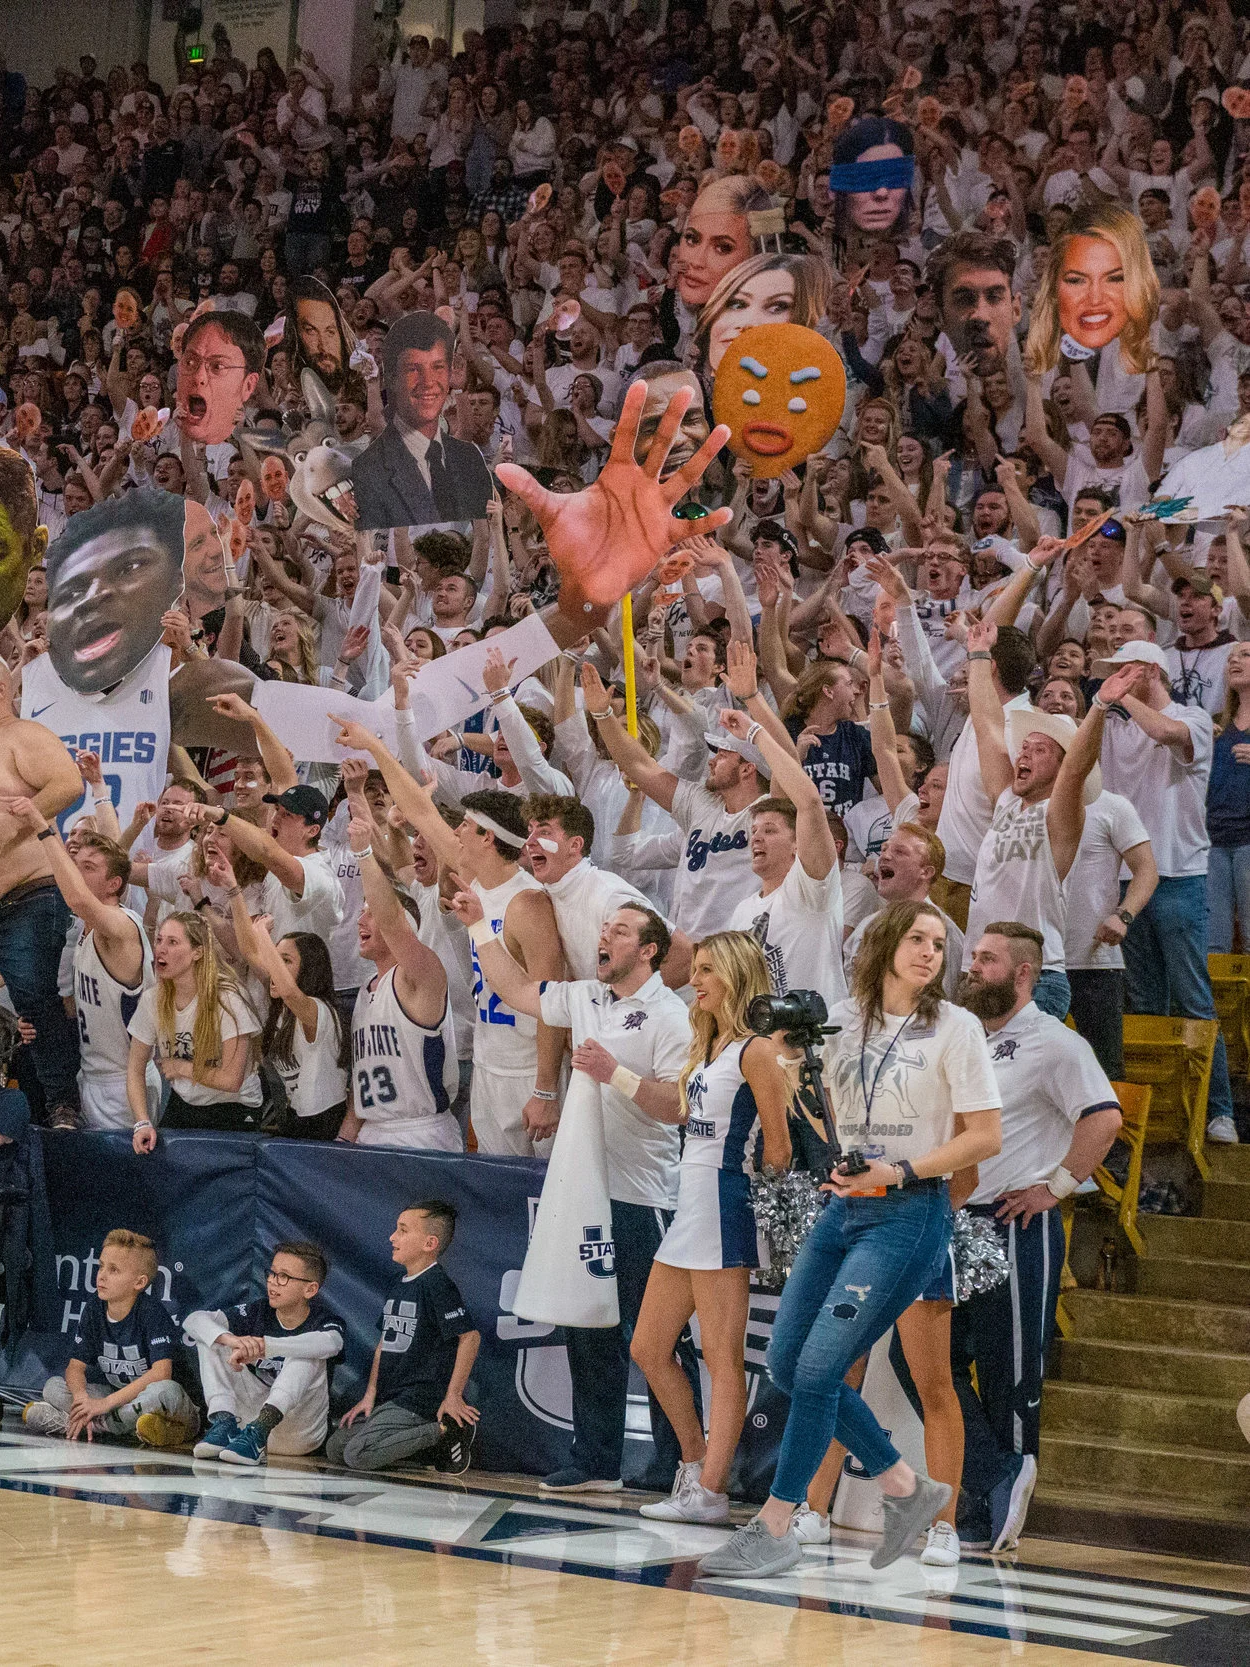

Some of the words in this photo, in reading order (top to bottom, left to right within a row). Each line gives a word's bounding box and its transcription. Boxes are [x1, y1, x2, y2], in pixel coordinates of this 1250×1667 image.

[295, 205, 320, 214] WAY
[59, 731, 157, 764] GGIES
[820, 780, 836, 803] 6
[1014, 823, 1045, 838] THE
[357, 1064, 398, 1109] 23
[97, 1355, 148, 1377] STATE
